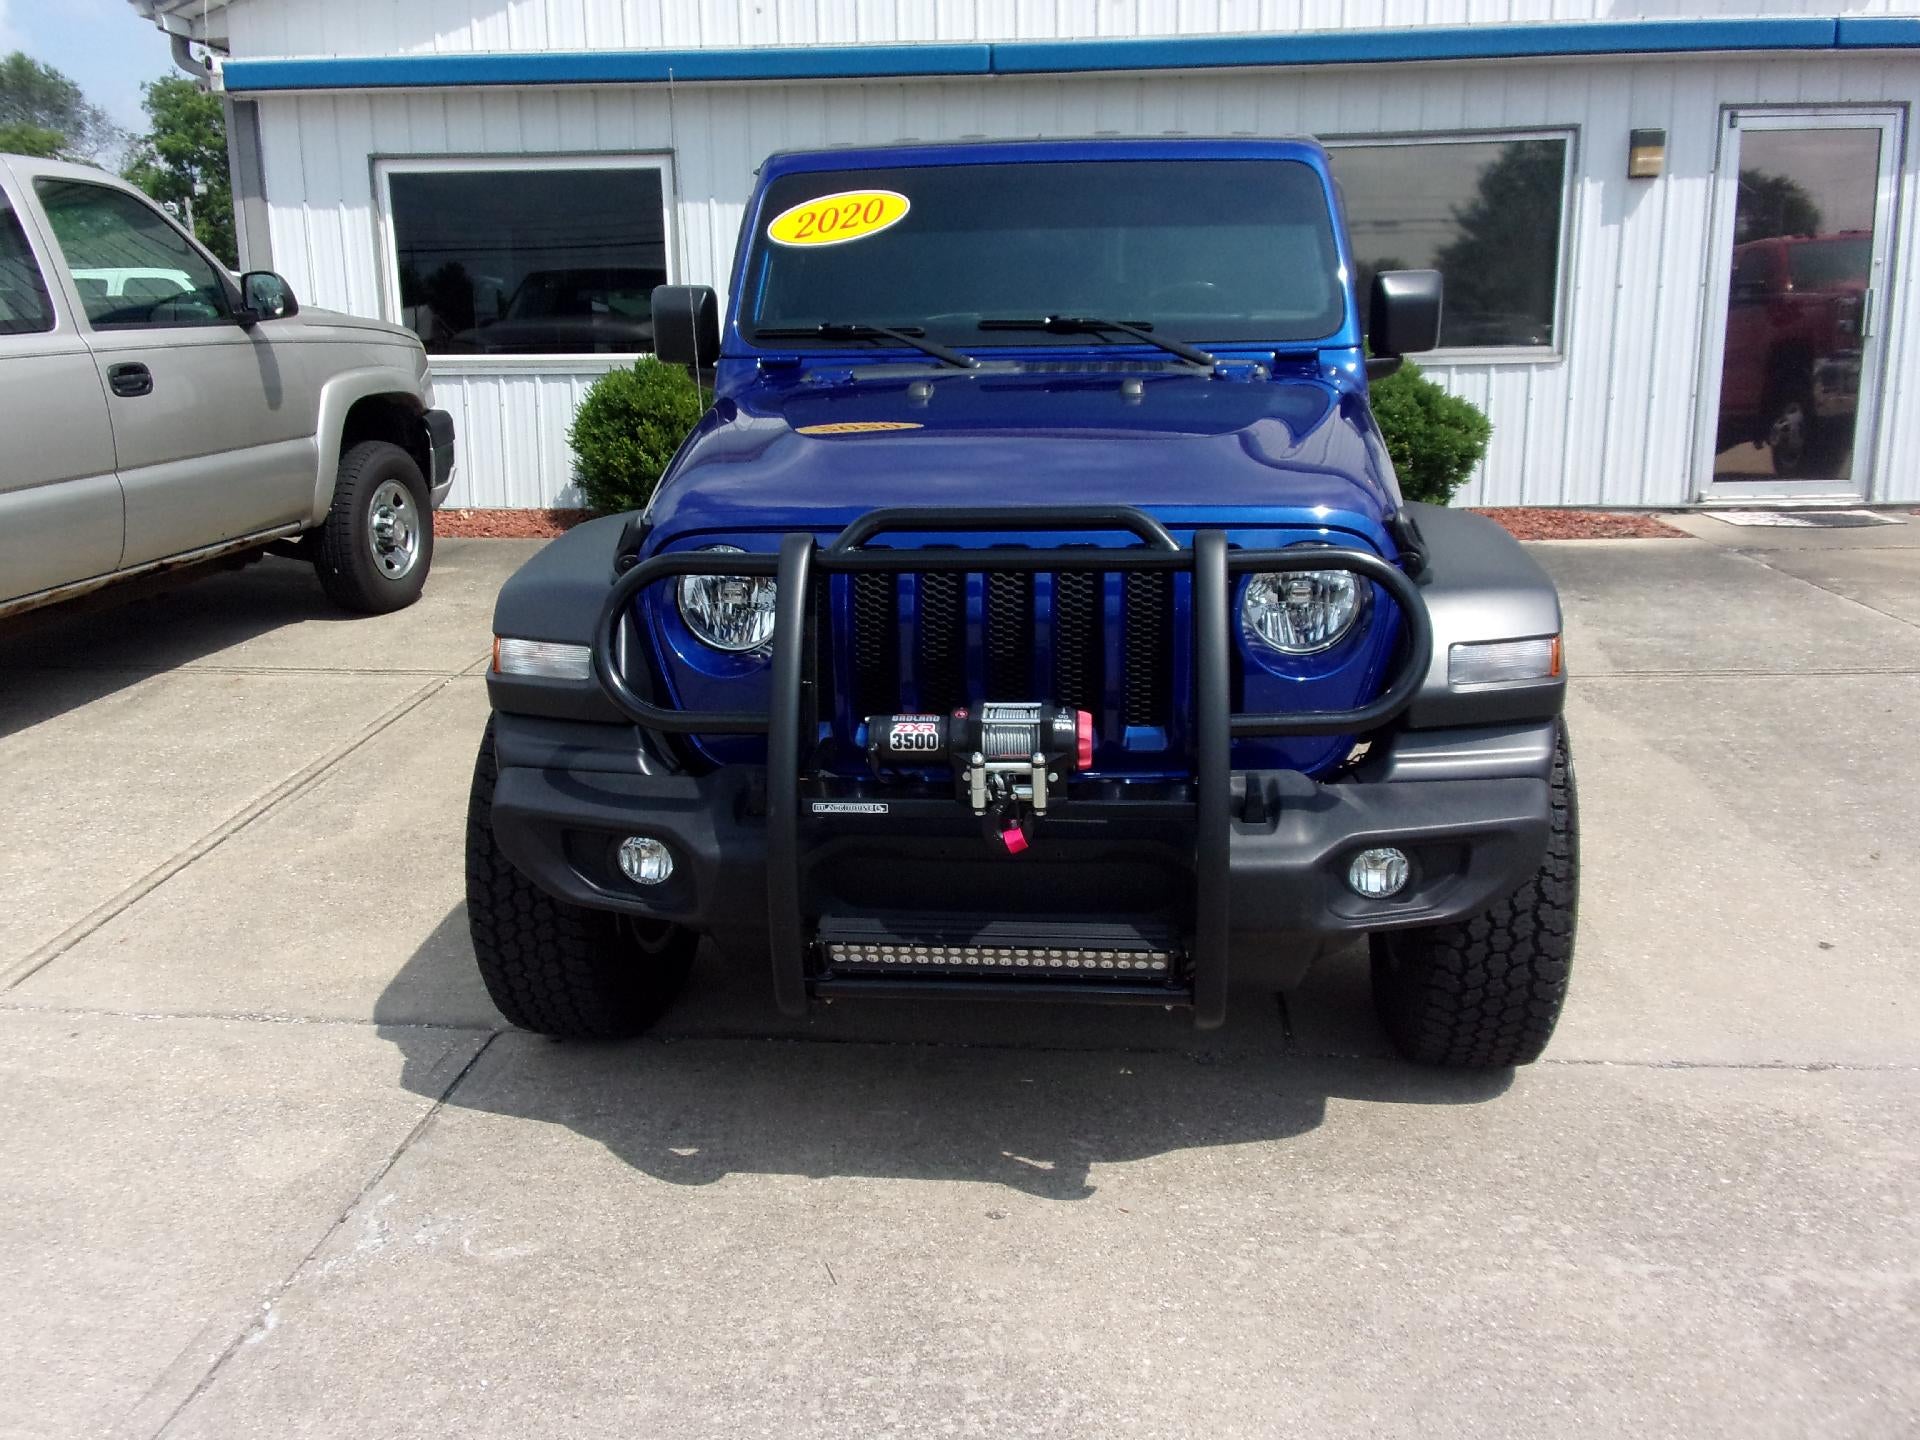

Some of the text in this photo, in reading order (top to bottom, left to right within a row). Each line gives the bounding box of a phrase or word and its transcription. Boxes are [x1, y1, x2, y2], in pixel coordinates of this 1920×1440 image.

[794, 198, 884, 239] 2020
[897, 723, 934, 732] ZXR
[892, 732, 937, 749] 3500
